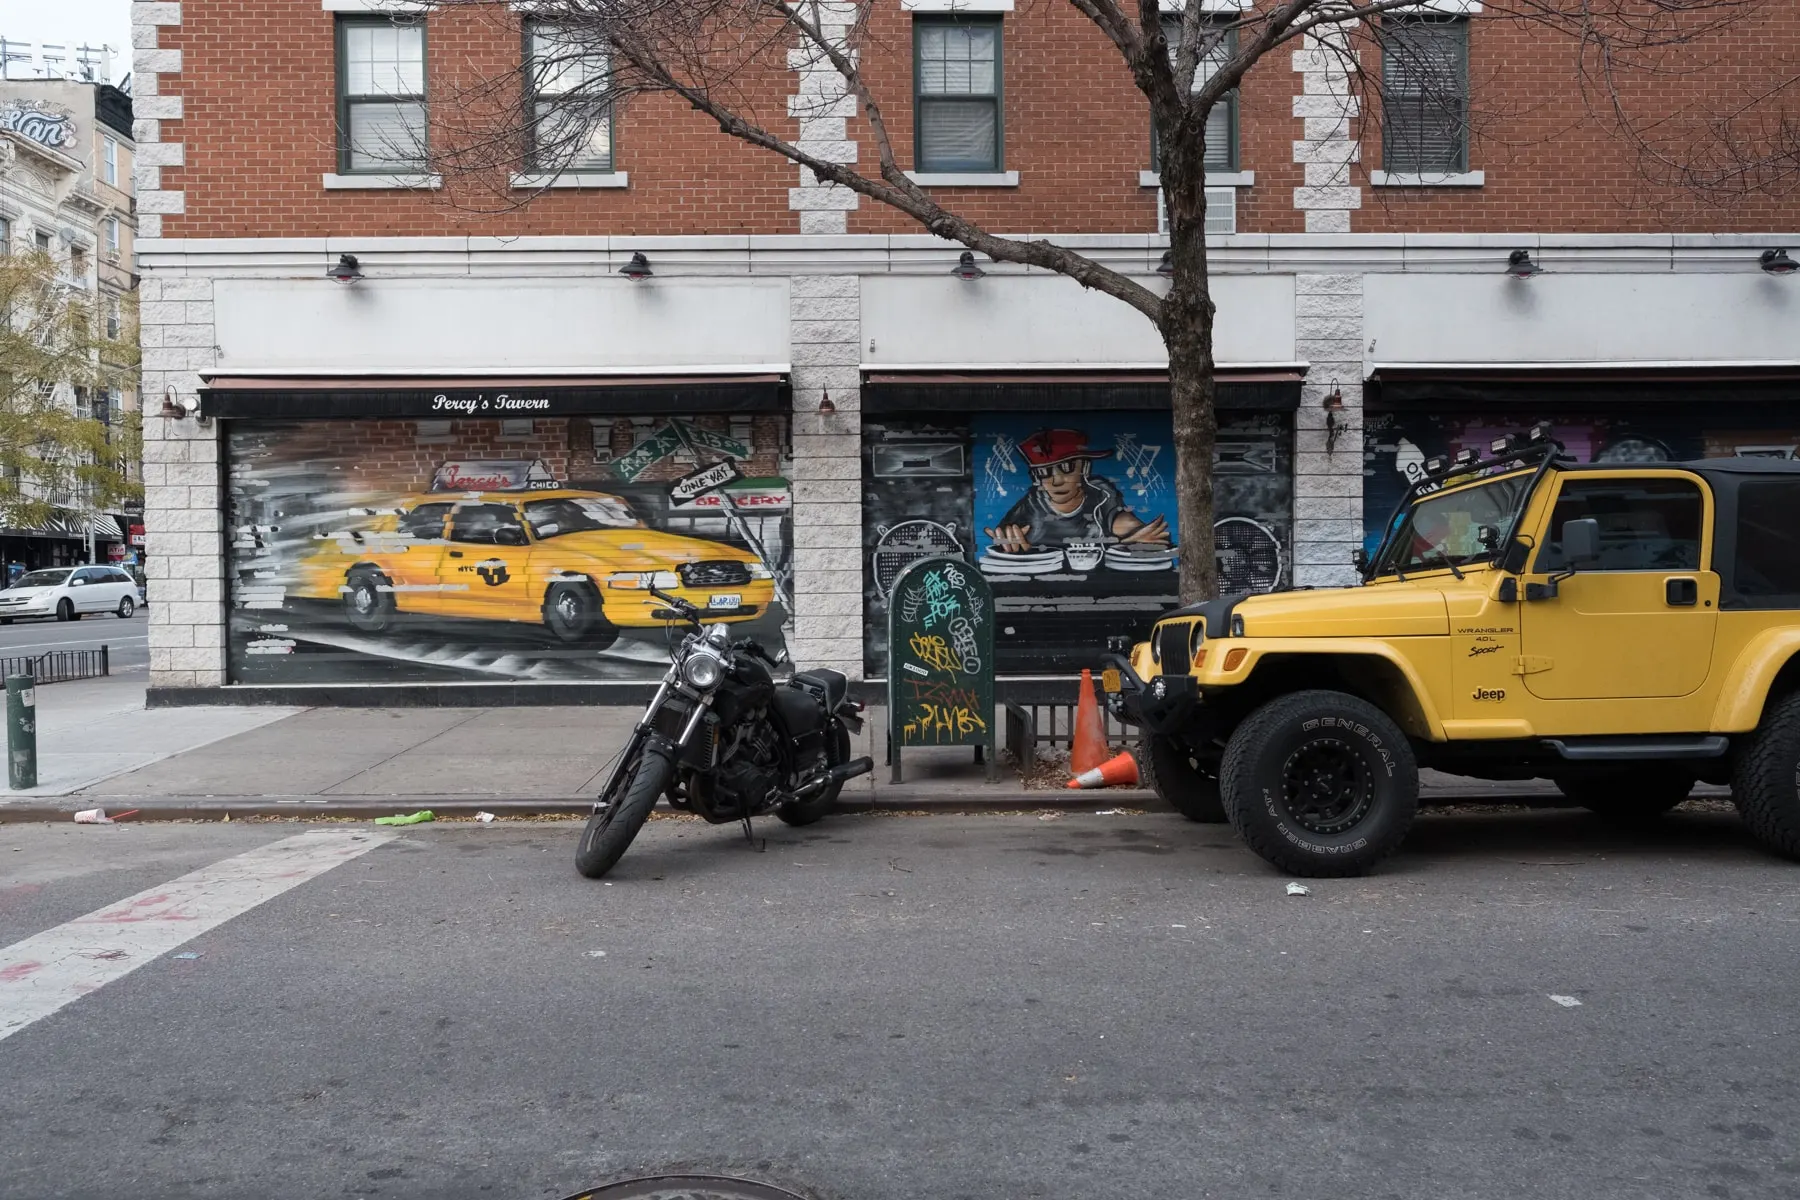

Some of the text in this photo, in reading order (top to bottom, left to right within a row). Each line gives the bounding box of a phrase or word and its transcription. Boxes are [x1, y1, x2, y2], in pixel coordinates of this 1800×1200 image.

[432, 394, 550, 414] Percy's Tavern
[530, 481, 559, 489] CHICO
[695, 495, 786, 506] GRCERY
[1473, 688, 1505, 701] Jeep
[1302, 717, 1396, 777] GENERAL
[1277, 822, 1367, 854] GRABBER
